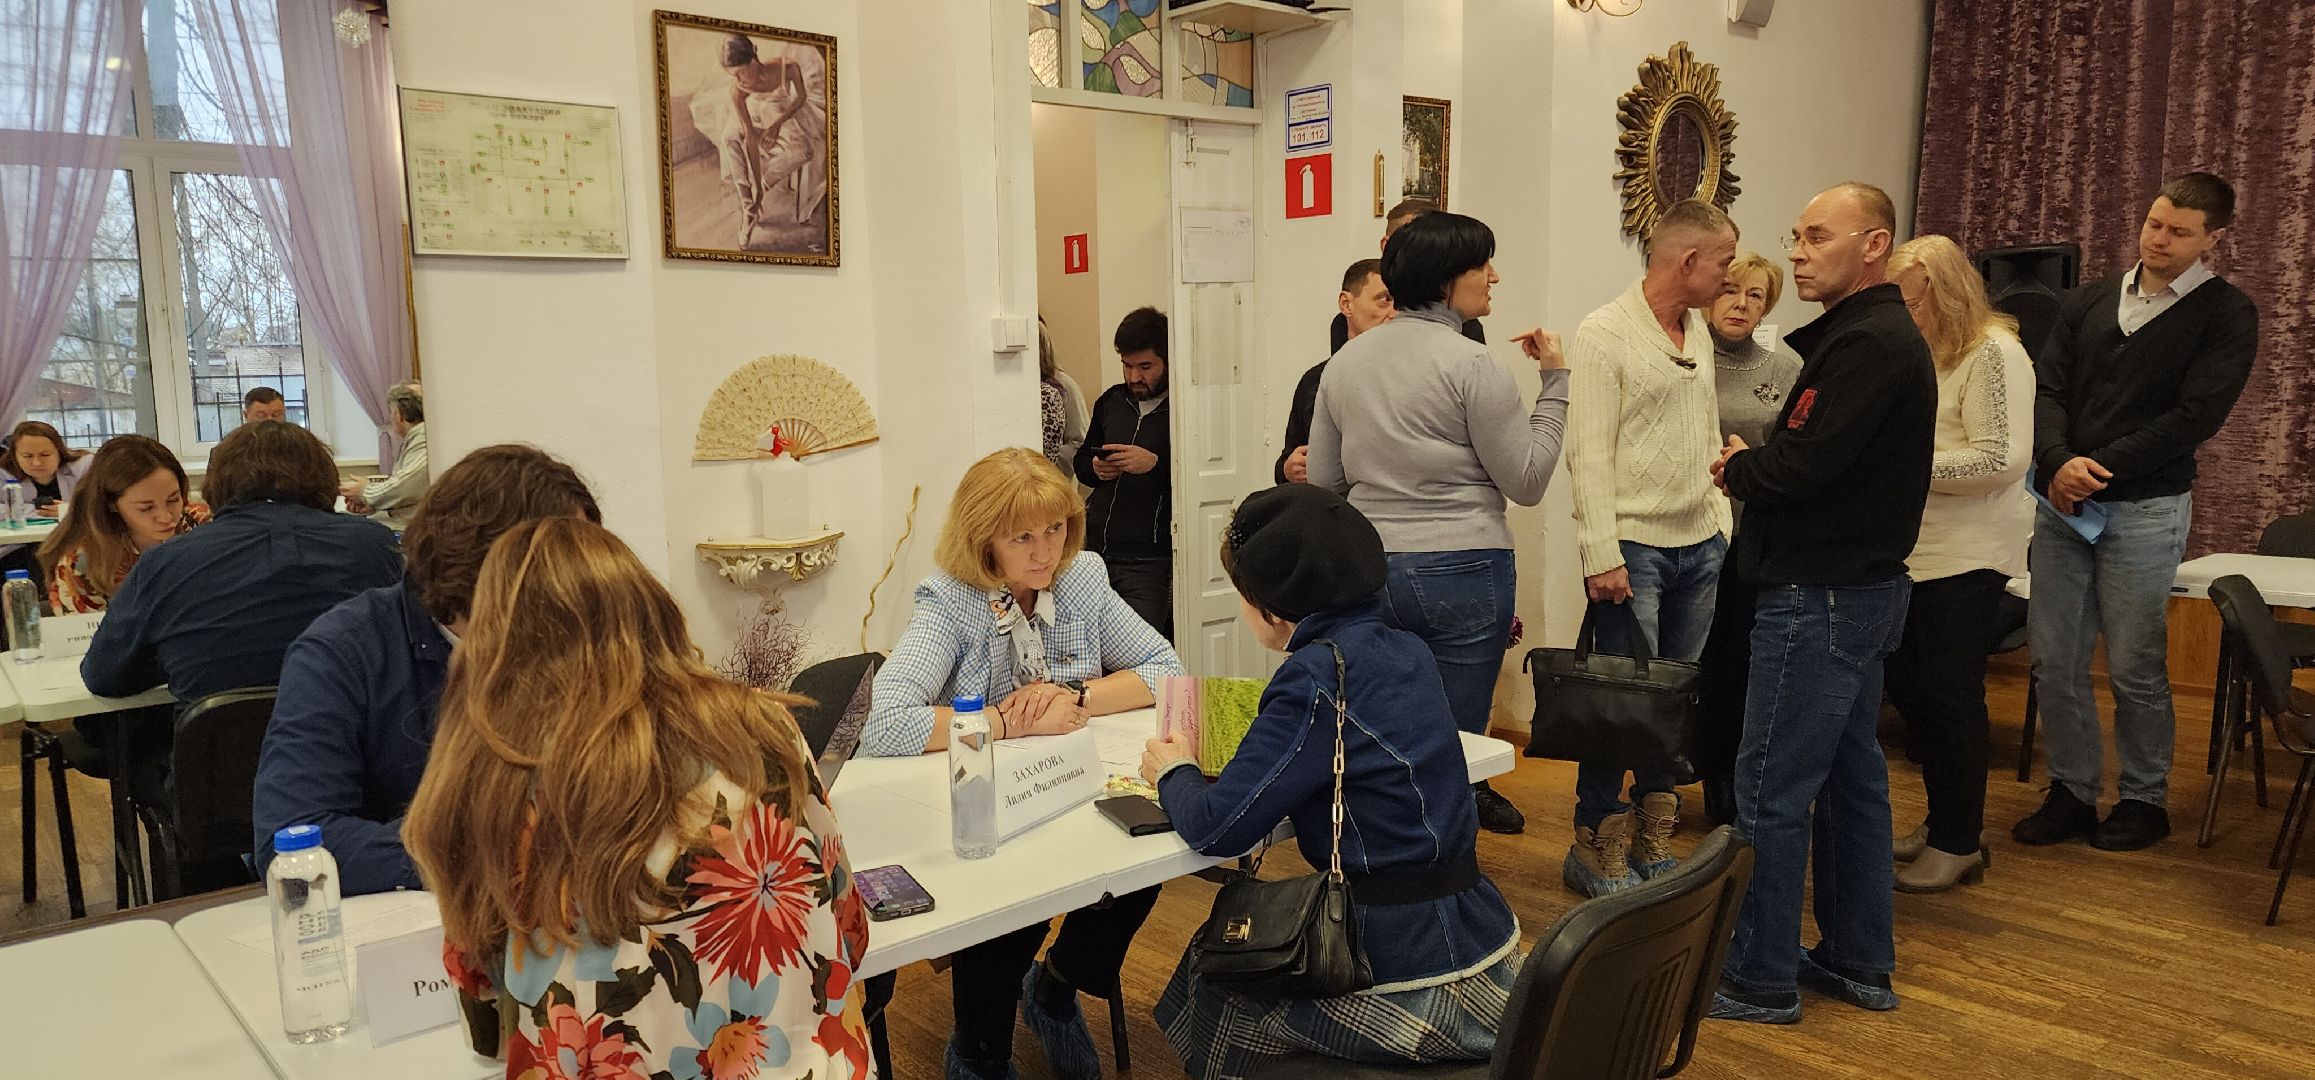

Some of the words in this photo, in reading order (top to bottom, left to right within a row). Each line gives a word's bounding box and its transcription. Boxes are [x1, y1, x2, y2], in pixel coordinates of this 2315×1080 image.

[1293, 132, 1308, 142] 101,
[1311, 129, 1325, 140] 112
[1013, 753, 1065, 783] ЗАХАРОВА
[1005, 789, 1033, 808] Лидия
[1034, 766, 1085, 796] Филипповна
